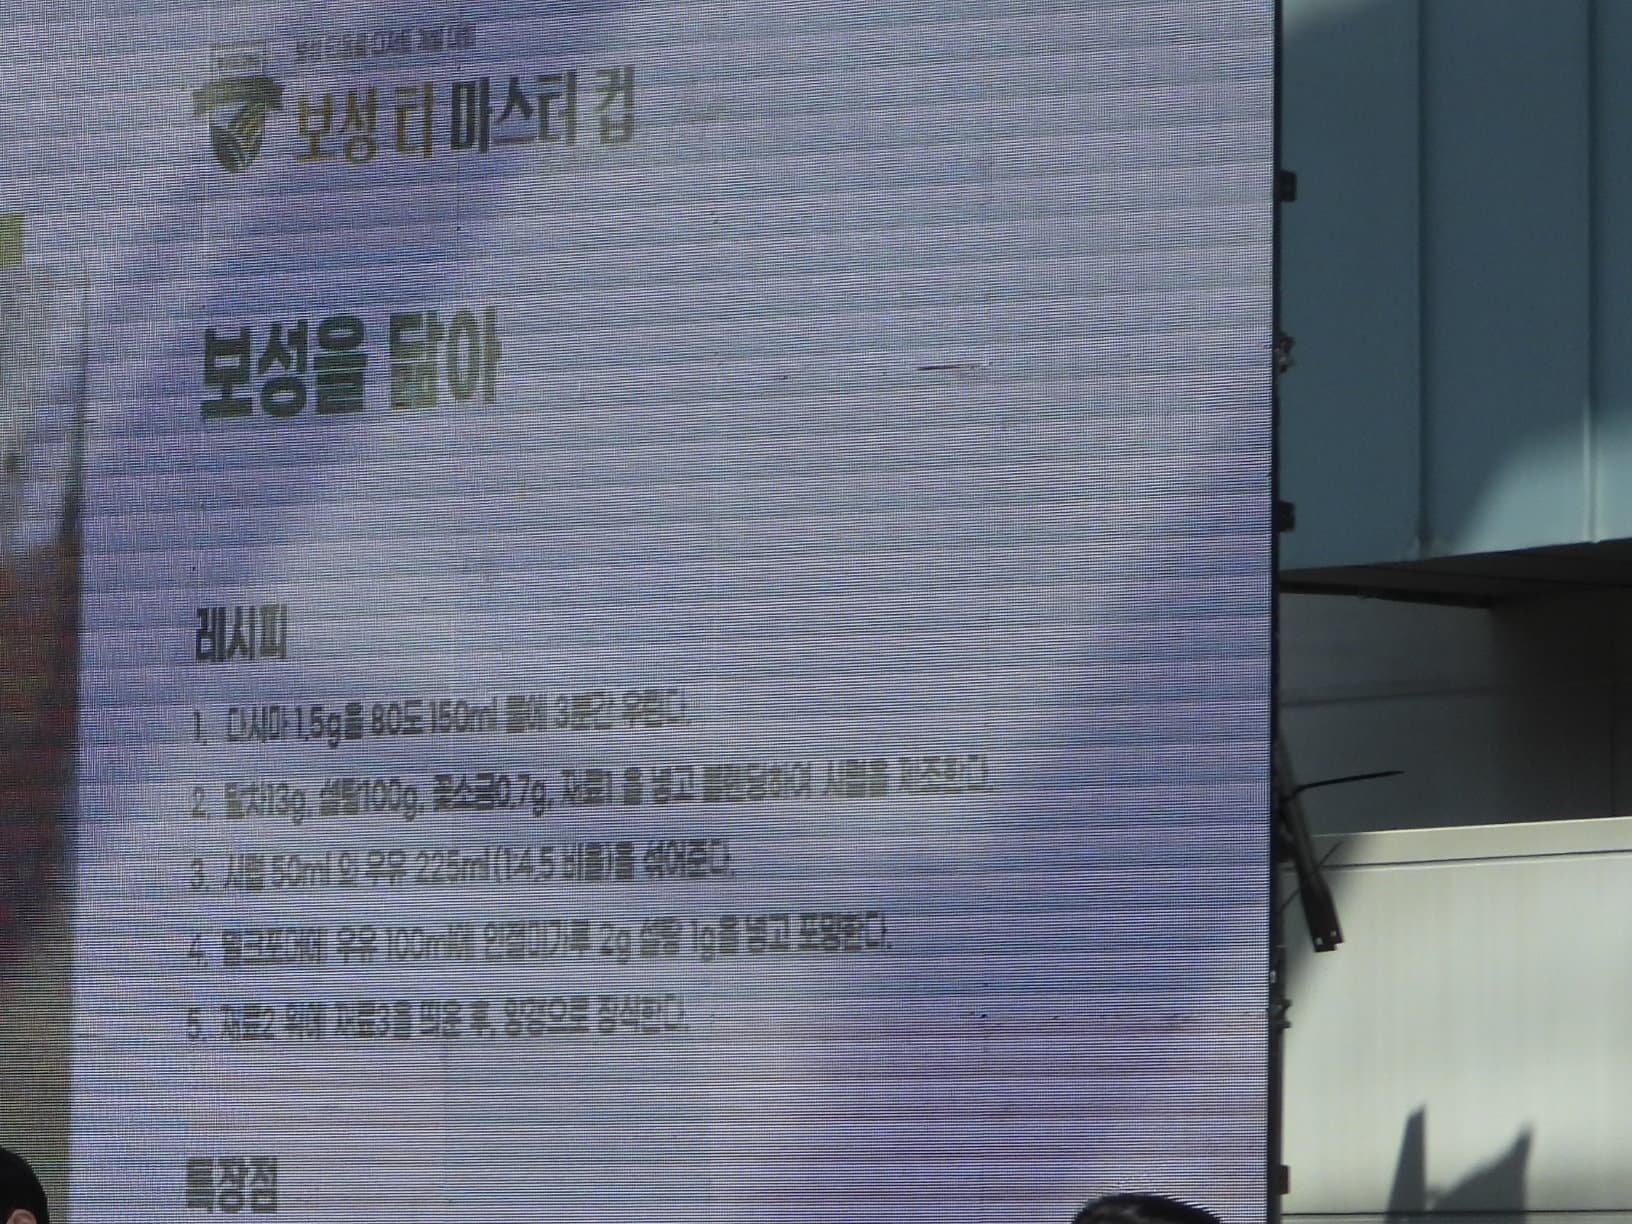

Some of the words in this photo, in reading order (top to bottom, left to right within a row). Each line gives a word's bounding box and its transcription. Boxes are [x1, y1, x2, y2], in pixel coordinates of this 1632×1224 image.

[296, 85, 377, 164] 보성
[394, 81, 434, 158] 티
[451, 69, 577, 154] 마스터
[595, 65, 635, 144] 컵
[201, 314, 367, 419] 보성을
[195, 604, 288, 664] 레시피
[193, 707, 207, 746] 1.
[228, 703, 289, 743] 다시마
[295, 700, 363, 748] 1.5g을
[371, 698, 424, 736] 80도
[429, 696, 497, 734] 150ml
[506, 693, 548, 734] 물에
[555, 690, 614, 731] 3분간
[622, 687, 691, 728] 우린다.
[191, 785, 211, 820] 2.
[433, 771, 552, 817] 꽃소금0.7g,
[652, 764, 694, 804] 넣고
[702, 760, 812, 803] 블렌딩하여
[823, 757, 889, 799] 시럽을
[898, 753, 994, 794] 제조한다.
[190, 857, 209, 893] 3.
[224, 852, 265, 892] 시럽
[270, 850, 331, 888] 50ml
[365, 848, 407, 887] 우유
[643, 838, 735, 880] 섞어준다.
[188, 932, 208, 968] 4.
[336, 924, 379, 965] 우유
[385, 921, 475, 962] 100ml에
[484, 917, 591, 961] 인절미가루
[599, 921, 632, 965] 2g
[746, 912, 790, 955] 넣고
[798, 910, 893, 953] 포밍한다.
[187, 1007, 207, 1042] 5.
[220, 1003, 276, 1041] 재료2
[284, 1001, 326, 1040] 위에
[420, 998, 463, 1039] 띄운
[469, 998, 496, 1038] 후,
[597, 993, 689, 1035] 장식한다.
[185, 1155, 278, 1214] 특장점
